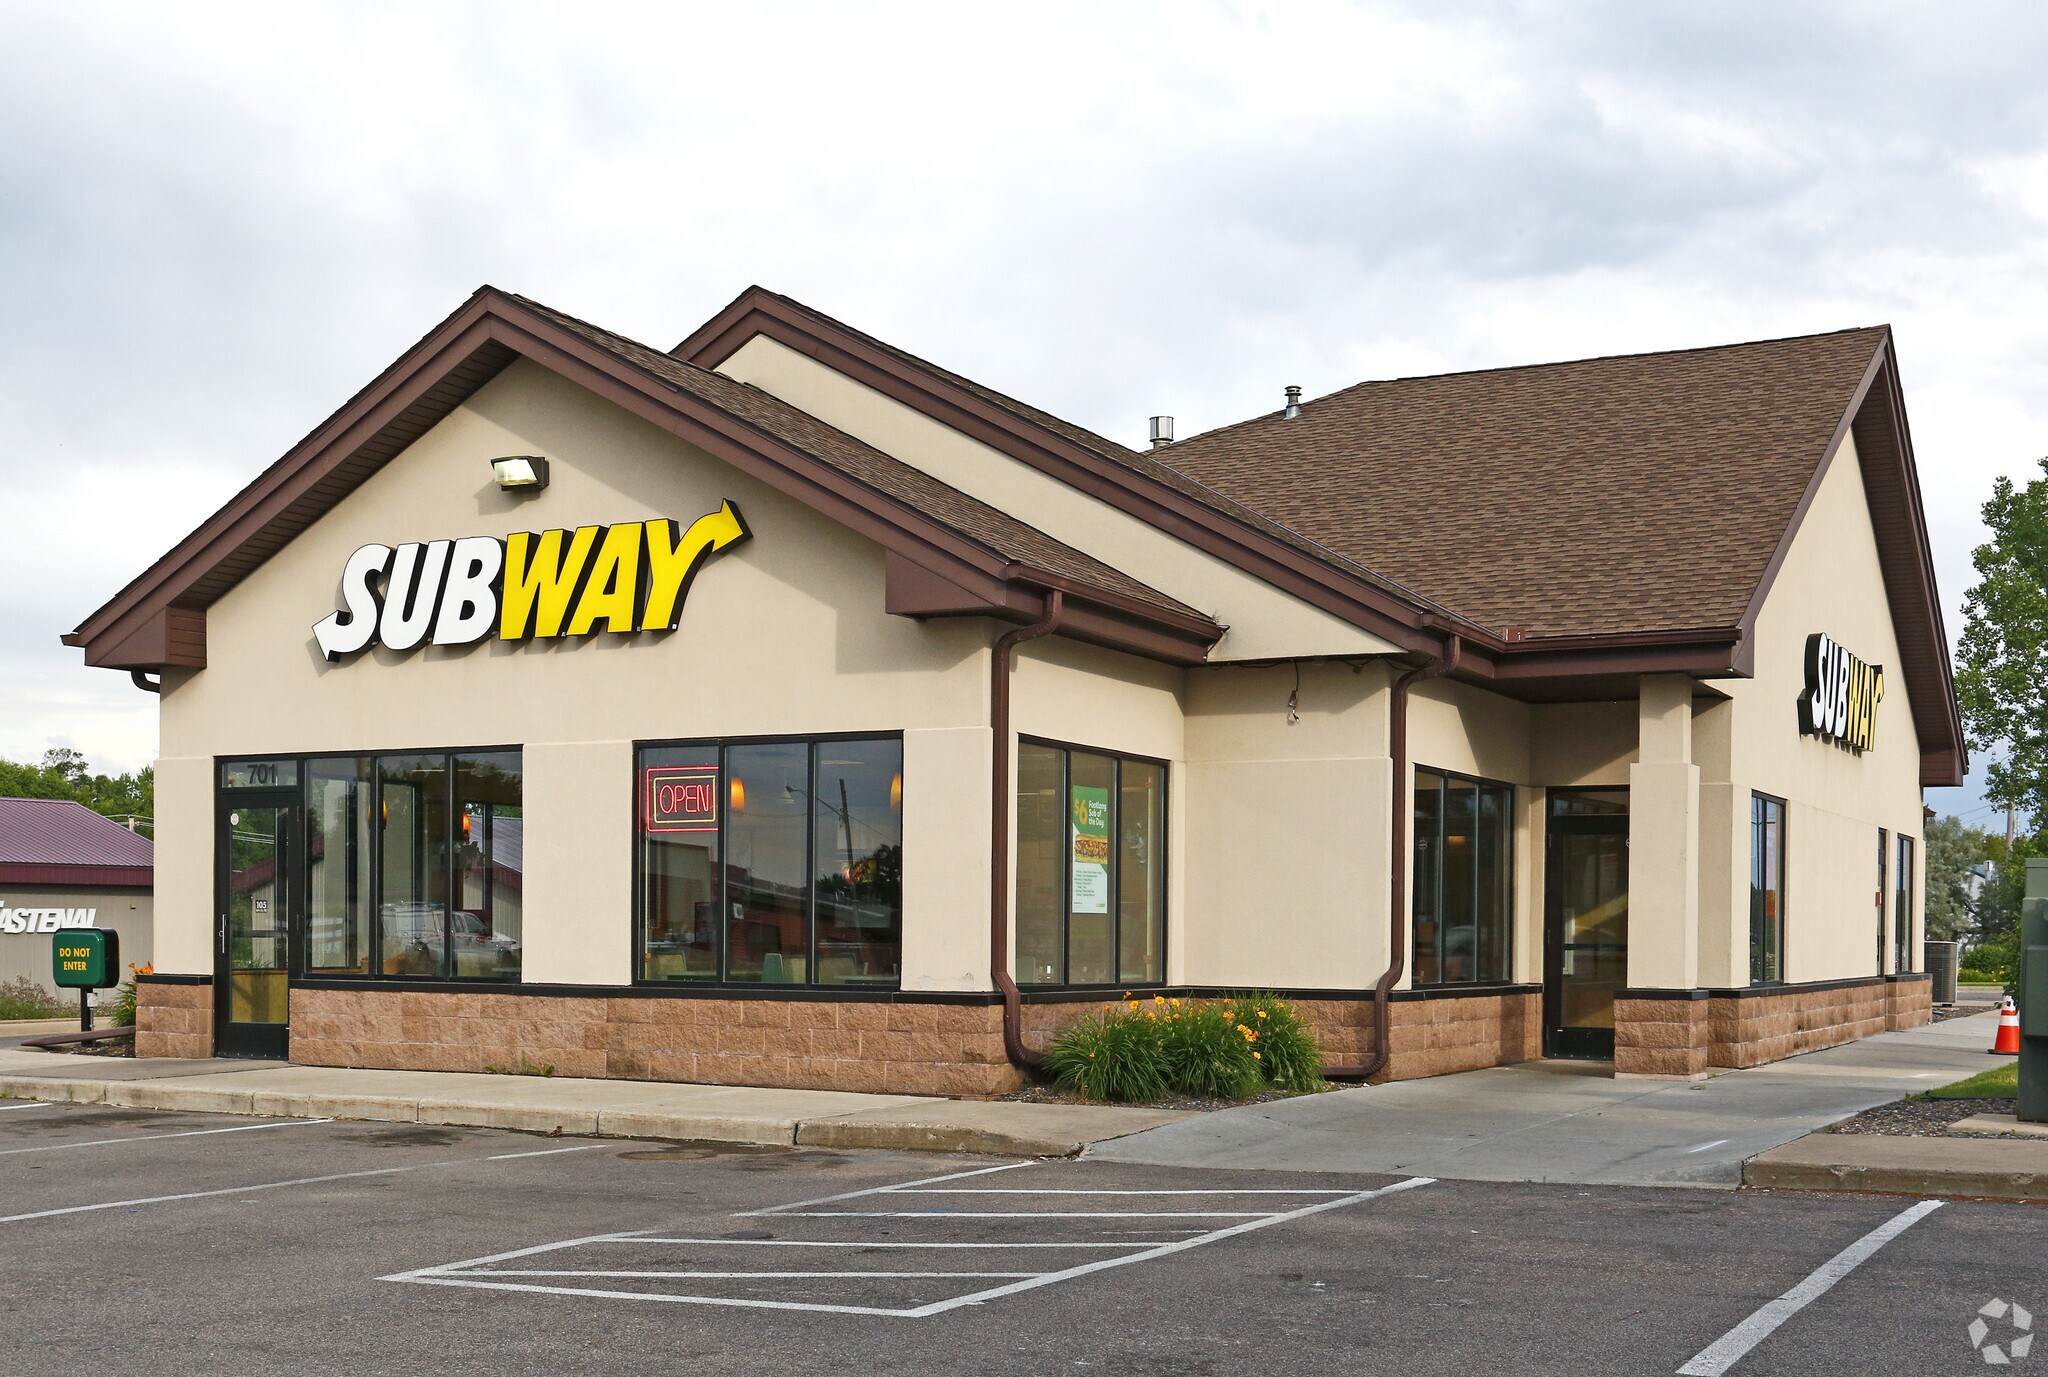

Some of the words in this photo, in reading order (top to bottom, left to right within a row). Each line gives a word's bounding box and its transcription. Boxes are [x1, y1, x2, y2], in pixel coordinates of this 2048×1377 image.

[311, 498, 754, 663] SUBWAY
[1806, 631, 1885, 753] SUBWAY
[247, 763, 276, 785] 701
[659, 783, 711, 815] OPEN
[1088, 800, 1107, 812] Footlong
[1074, 799, 1089, 826] $6
[1088, 808, 1097, 818] Sub
[1096, 809, 1102, 818] of
[1088, 816, 1096, 826] the
[1095, 817, 1105, 829] Day
[0, 900, 100, 934] ASTENAL
[59, 948, 71, 957] DO
[73, 948, 91, 957] NOT
[63, 961, 87, 971] ENTER
